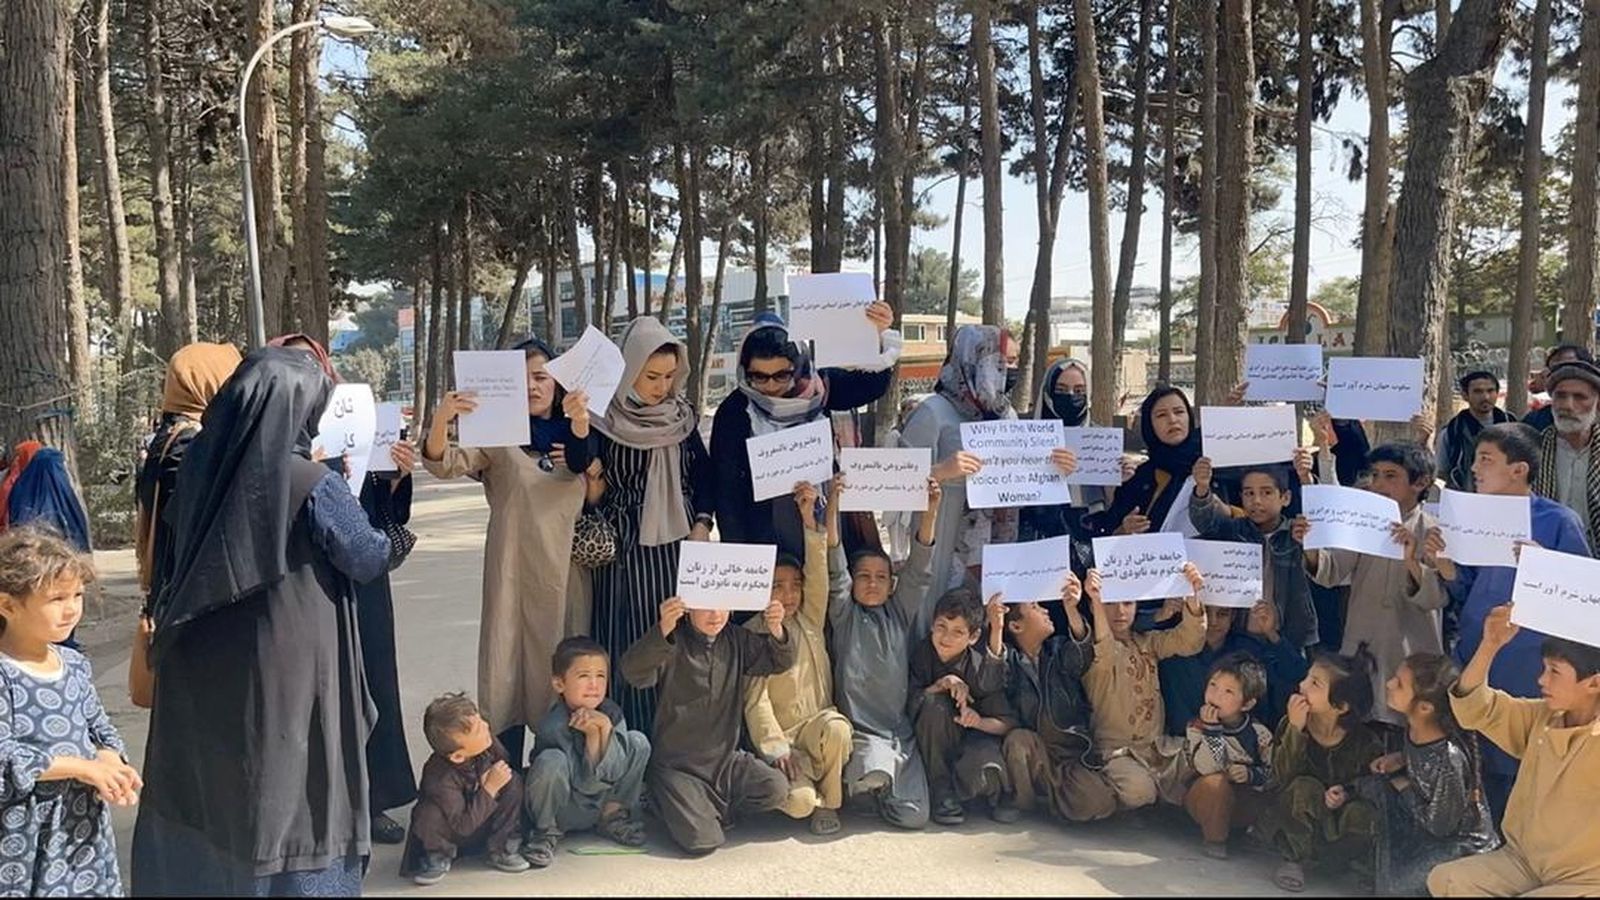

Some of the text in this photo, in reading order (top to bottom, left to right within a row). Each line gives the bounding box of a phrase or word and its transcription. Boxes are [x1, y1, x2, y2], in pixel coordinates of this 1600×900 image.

[969, 422, 1055, 435] Why is the World
[968, 438, 1028, 449] Community
[1001, 457, 1018, 468] you
[1020, 455, 1043, 465] hear
[1001, 473, 1011, 484] of
[1015, 476, 1026, 484] an
[1028, 472, 1060, 485] Afghan
[997, 491, 1041, 503] Woman?
[1125, 555, 1132, 566] از
[686, 561, 769, 576] جامعه خالی از زنان
[680, 577, 770, 591] محکوم به نابودی است
